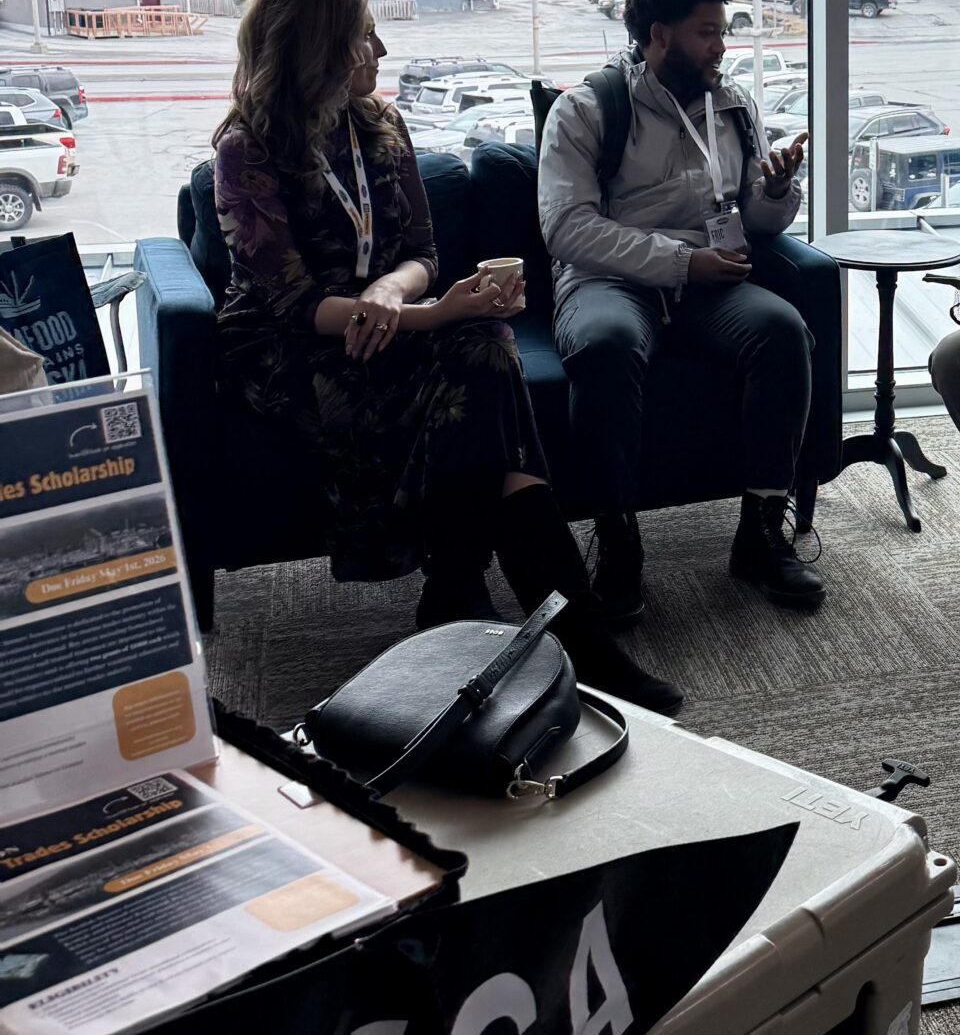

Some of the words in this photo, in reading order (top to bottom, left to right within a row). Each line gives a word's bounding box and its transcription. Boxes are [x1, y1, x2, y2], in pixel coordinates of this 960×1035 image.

[30, 456, 136, 495] Scholarship
[41, 582, 61, 595] Due
[64, 571, 97, 590] Friday
[99, 565, 123, 579] May
[144, 553, 167, 568] 2026
[780, 786, 870, 831] YETI
[3, 841, 73, 869] Trades
[74, 798, 184, 846] Scholarship
[27, 966, 121, 1012] ELIGIBILITY
